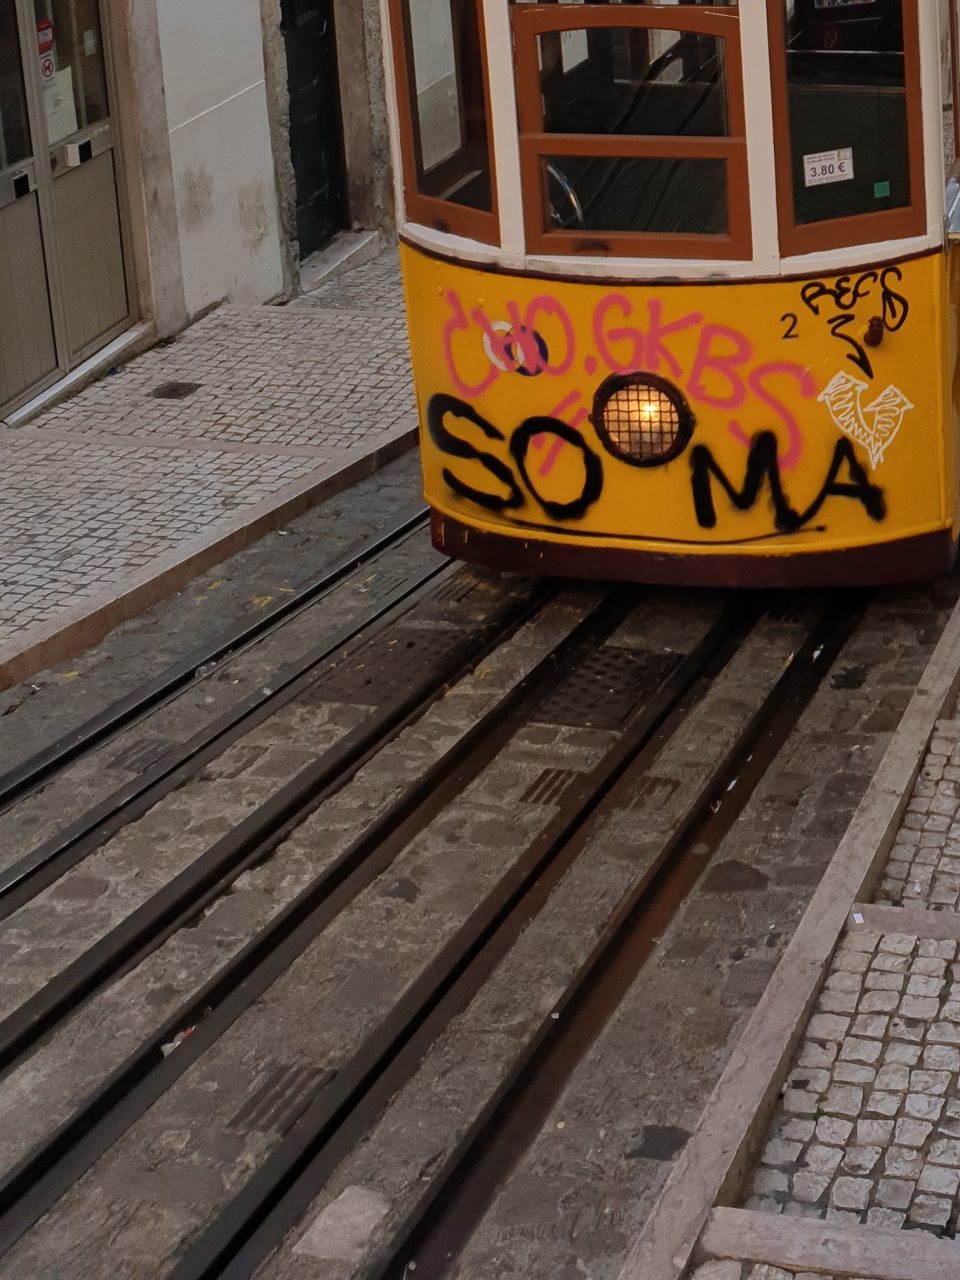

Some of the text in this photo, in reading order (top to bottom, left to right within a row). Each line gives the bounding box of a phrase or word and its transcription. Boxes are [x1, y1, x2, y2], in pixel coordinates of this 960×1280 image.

[810, 161, 846, 177] 3.80 €
[780, 313, 800, 339] 2
